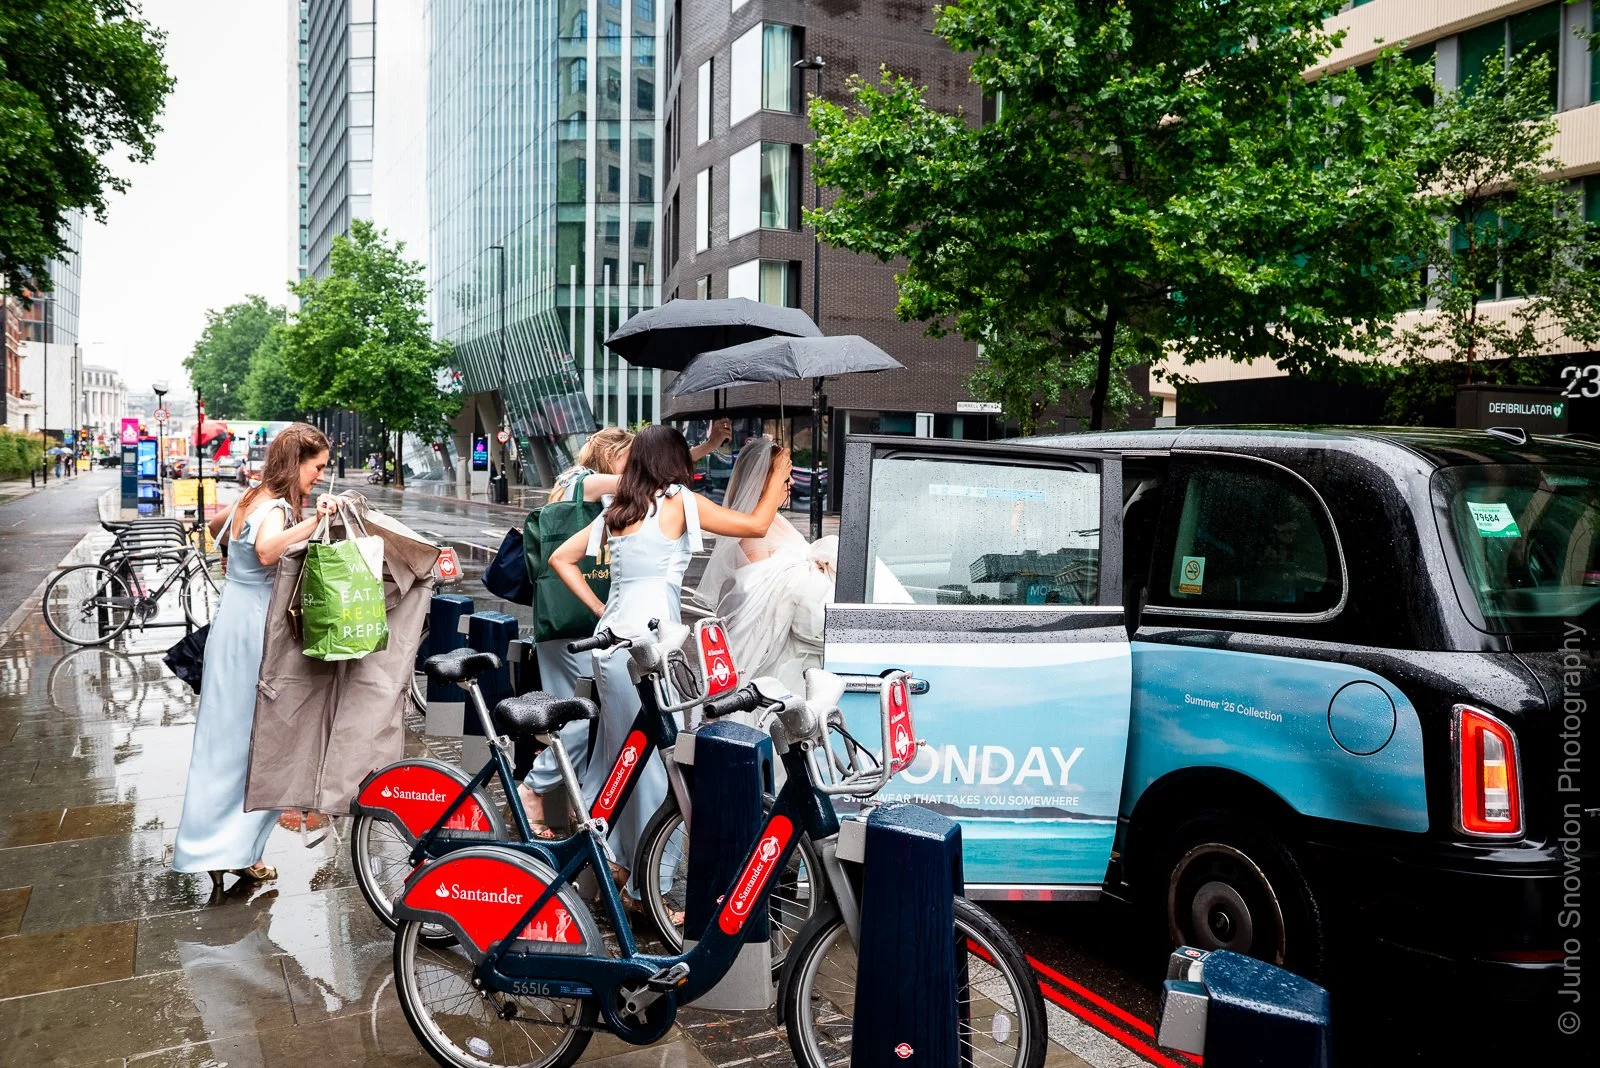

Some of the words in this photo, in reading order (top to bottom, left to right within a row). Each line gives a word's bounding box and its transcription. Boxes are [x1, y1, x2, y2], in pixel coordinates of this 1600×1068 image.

[1560, 365, 1600, 398] 23
[1489, 402, 1552, 415] DEFIBRILLATOR
[1474, 513, 1500, 522] 79684
[341, 587, 374, 604] EAT.
[1184, 694, 1219, 709] Summer
[1237, 704, 1283, 722] Collection
[857, 744, 1084, 786] ONDAY
[606, 767, 626, 799] Santander
[393, 786, 447, 803] Santander
[914, 794, 944, 804] THAT
[947, 795, 981, 805] TAKES
[983, 796, 1005, 805] YOU
[1007, 796, 1080, 806] SOMEWHERE
[738, 861, 764, 902] Santander
[451, 883, 523, 905] Santander
[512, 981, 550, 996] 56516
